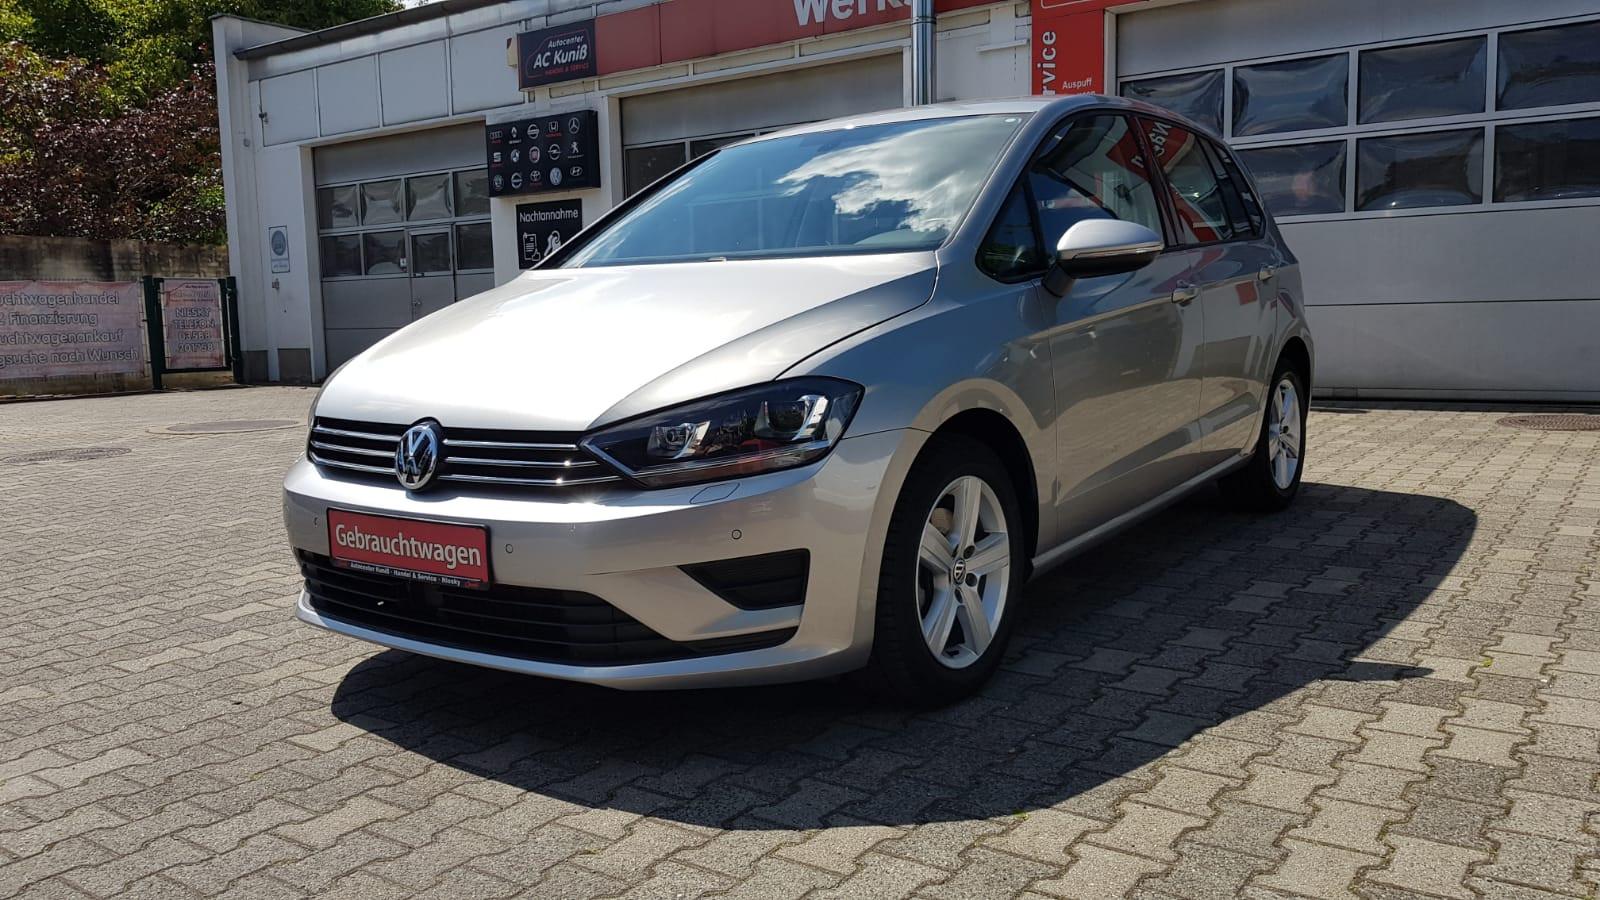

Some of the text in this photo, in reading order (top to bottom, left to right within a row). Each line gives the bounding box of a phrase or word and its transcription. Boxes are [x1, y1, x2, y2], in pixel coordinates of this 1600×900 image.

[548, 35, 584, 48] Autocenter
[533, 44, 588, 69] AC Kuniß
[1062, 77, 1092, 90] Auspuff
[520, 208, 579, 223] Nachtannahme
[9, 311, 97, 326] Finanzierung
[176, 307, 211, 317] NIESKY
[174, 319, 215, 329] TELEFON
[51, 348, 84, 363] nach
[87, 346, 138, 361] Wunsch
[335, 524, 481, 570] Gebrauchtwagen
[393, 570, 411, 579] Handel
[412, 572, 417, 580] &
[417, 573, 437, 582] Service
[441, 577, 461, 587] Niesky
